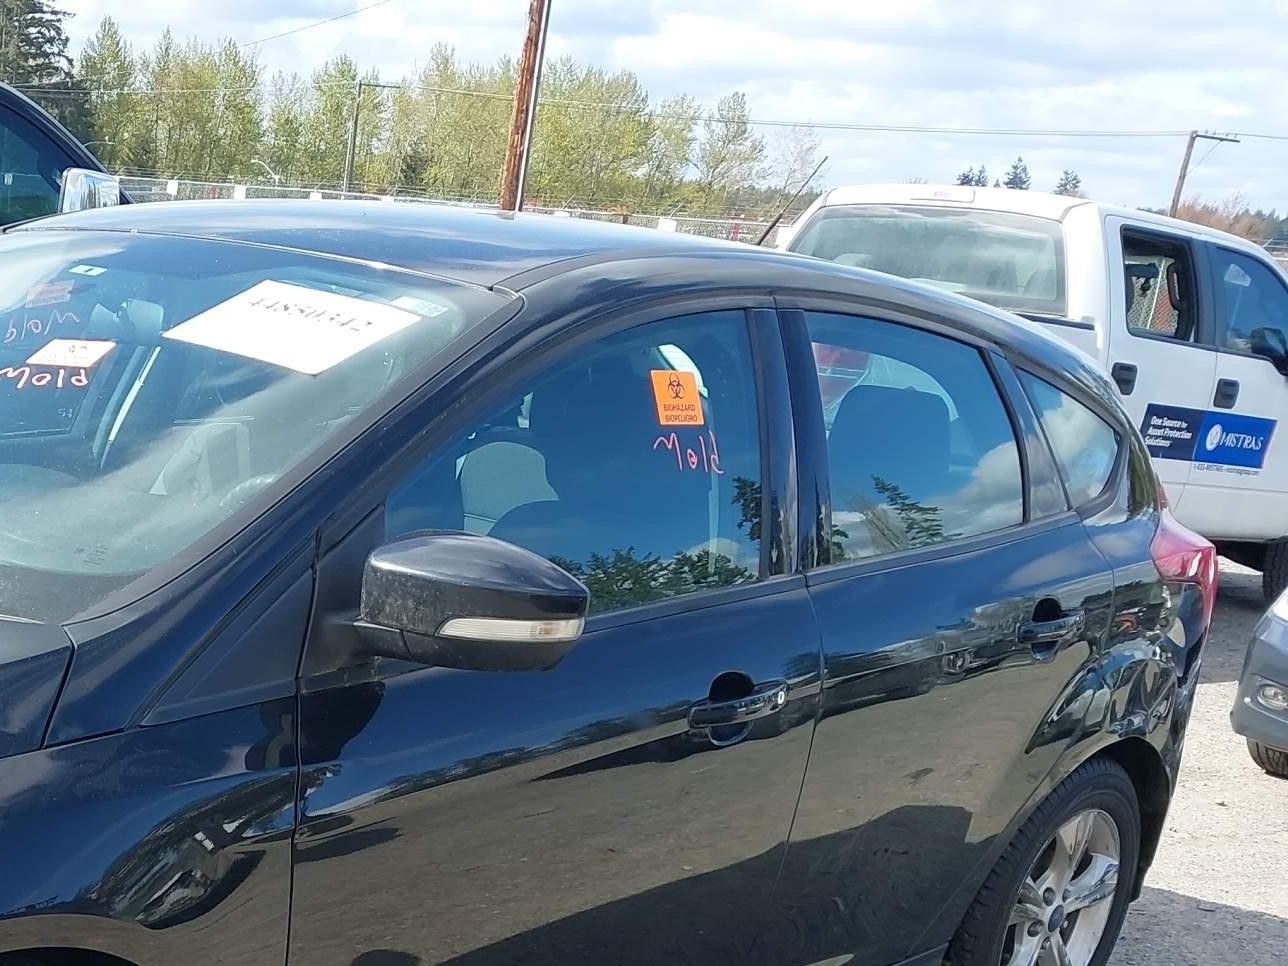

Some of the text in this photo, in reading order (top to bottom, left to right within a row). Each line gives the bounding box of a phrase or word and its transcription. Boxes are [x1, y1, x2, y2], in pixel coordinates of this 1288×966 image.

[663, 403, 696, 412] BIOHAZARD
[1150, 416, 1162, 425] One
[1162, 417, 1181, 427] Source
[1148, 427, 1192, 439] Asset Protection
[1220, 432, 1263, 451] MISTRAS
